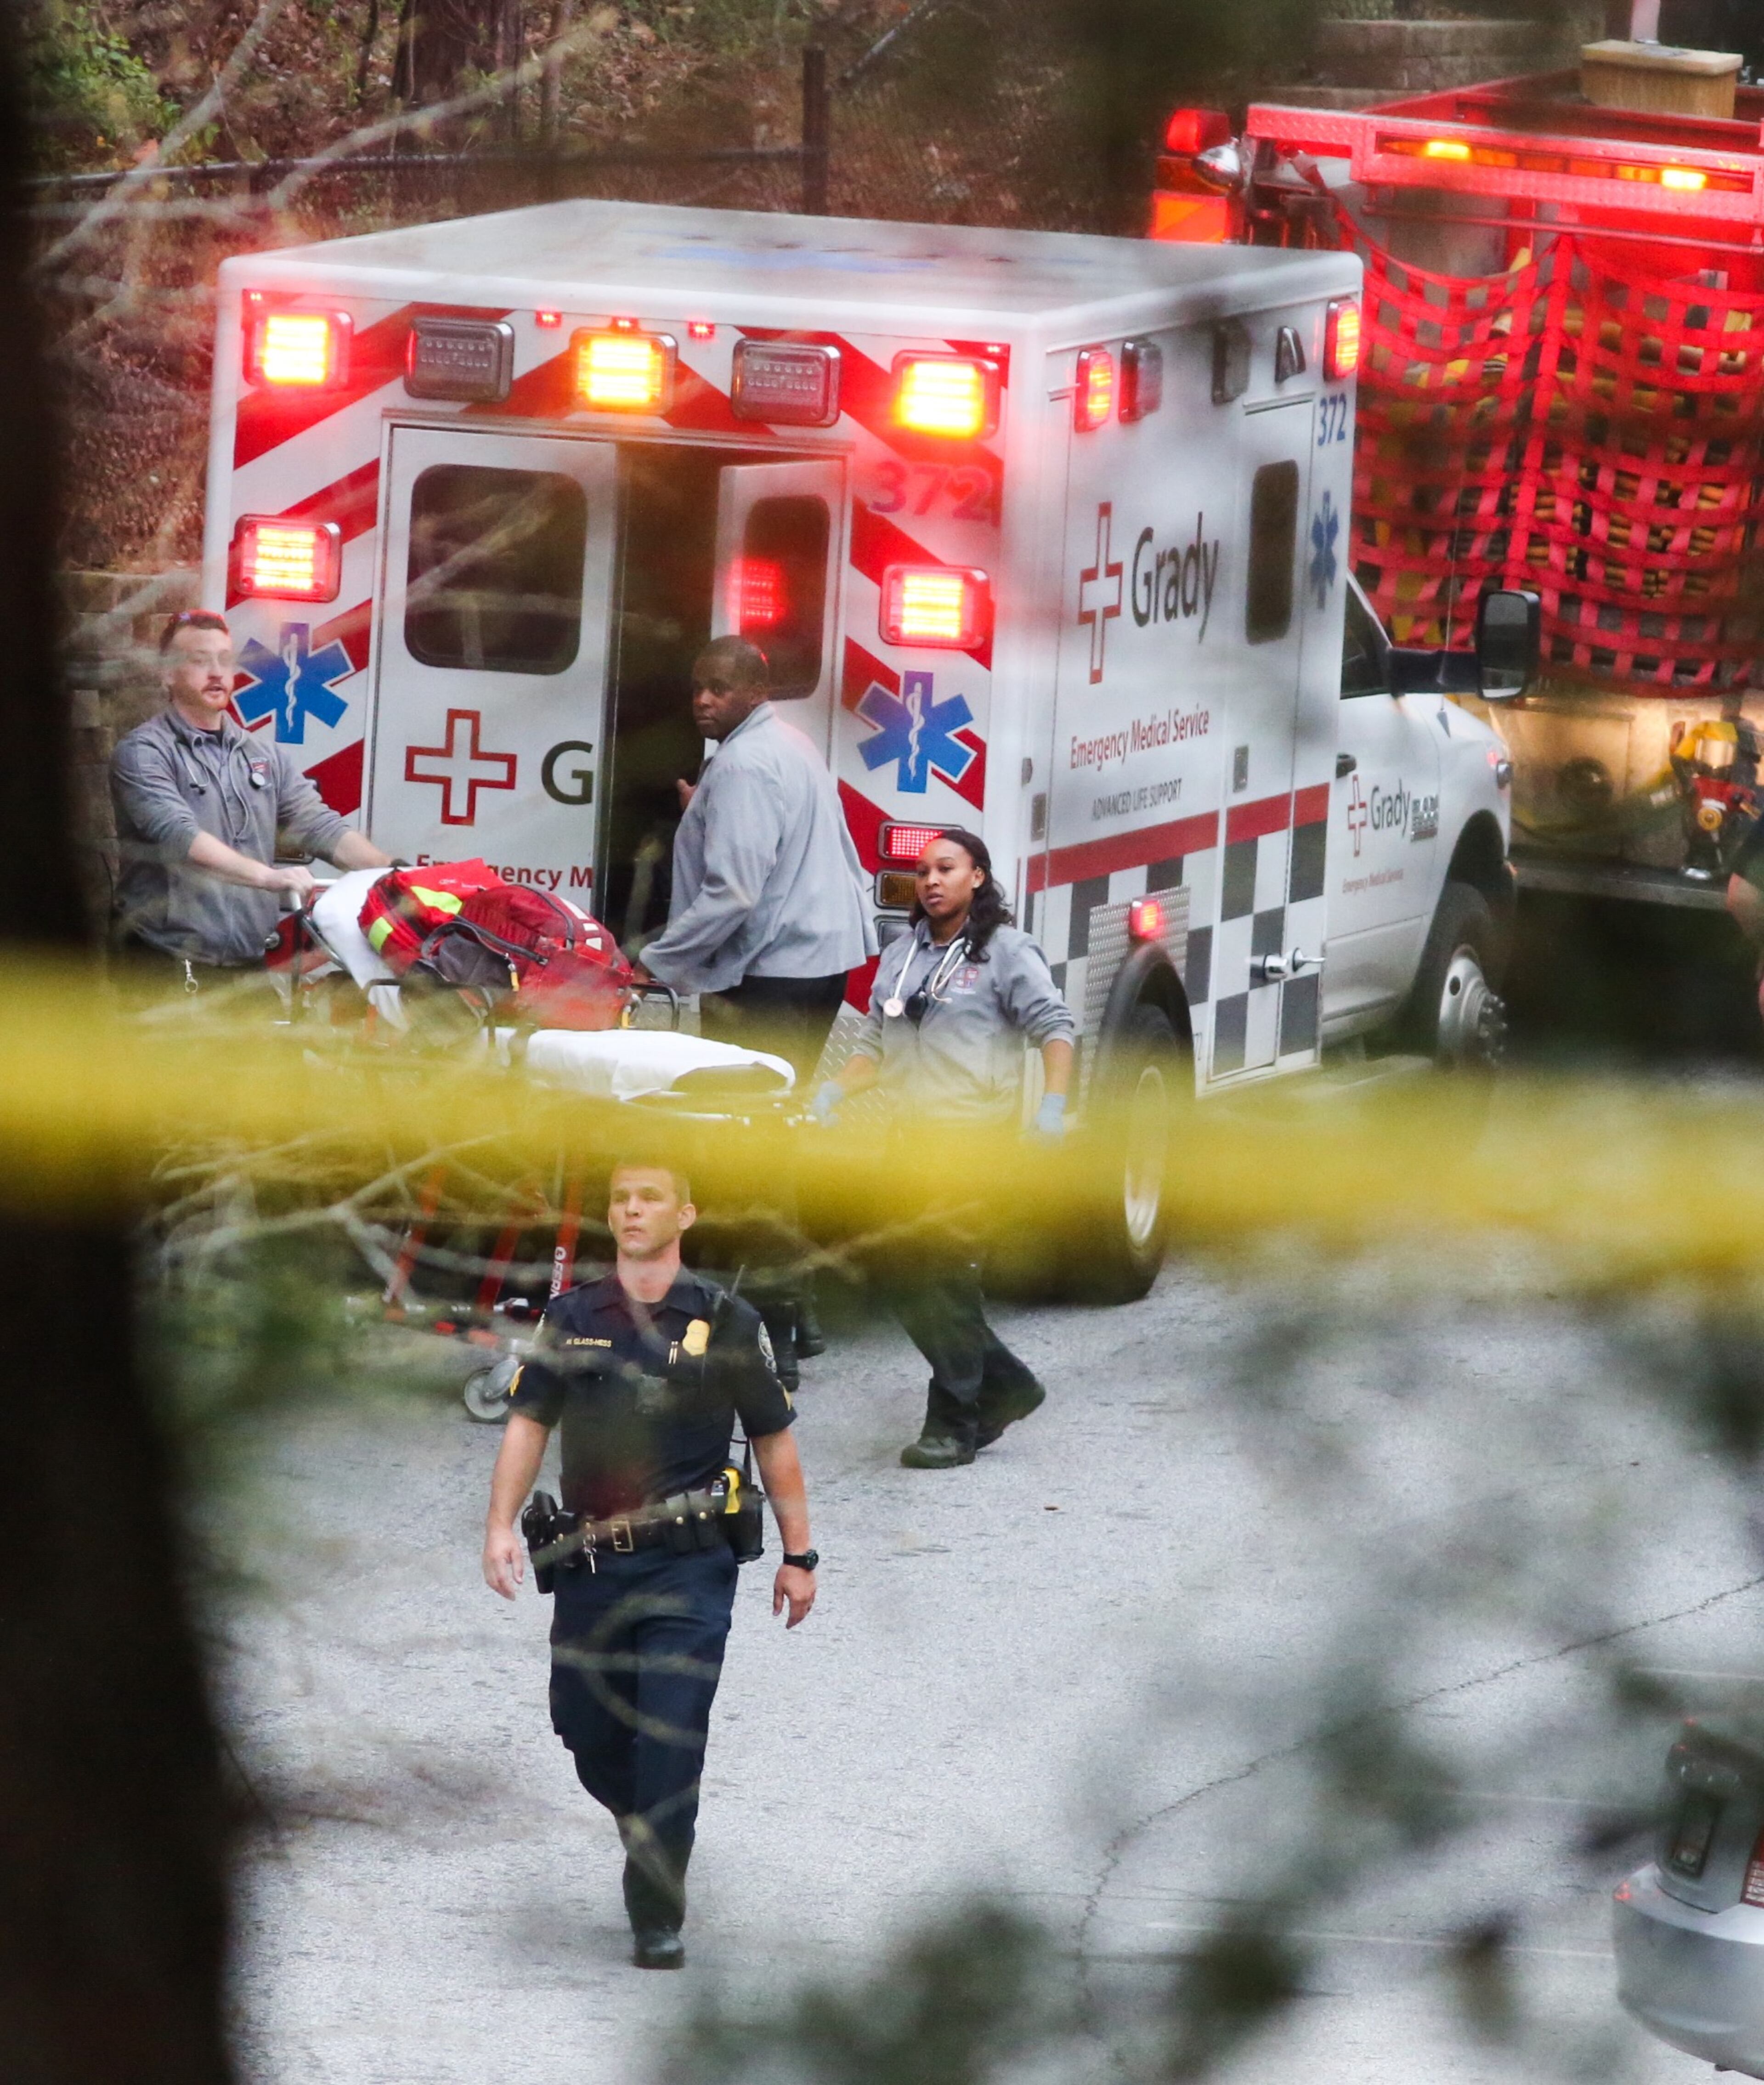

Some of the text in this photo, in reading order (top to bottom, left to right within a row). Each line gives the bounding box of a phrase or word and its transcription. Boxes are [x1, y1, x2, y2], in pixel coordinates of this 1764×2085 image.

[1317, 392, 1346, 446] 372
[866, 459, 992, 522] 372
[1131, 511, 1220, 644] Grady
[1070, 703, 1209, 771] Emergency Medical Service
[541, 740, 593, 805] G
[1092, 778, 1182, 820] ADVANCED LIFE SUPPORT
[1371, 779, 1410, 836] Grady
[417, 855, 593, 891] Eency M
